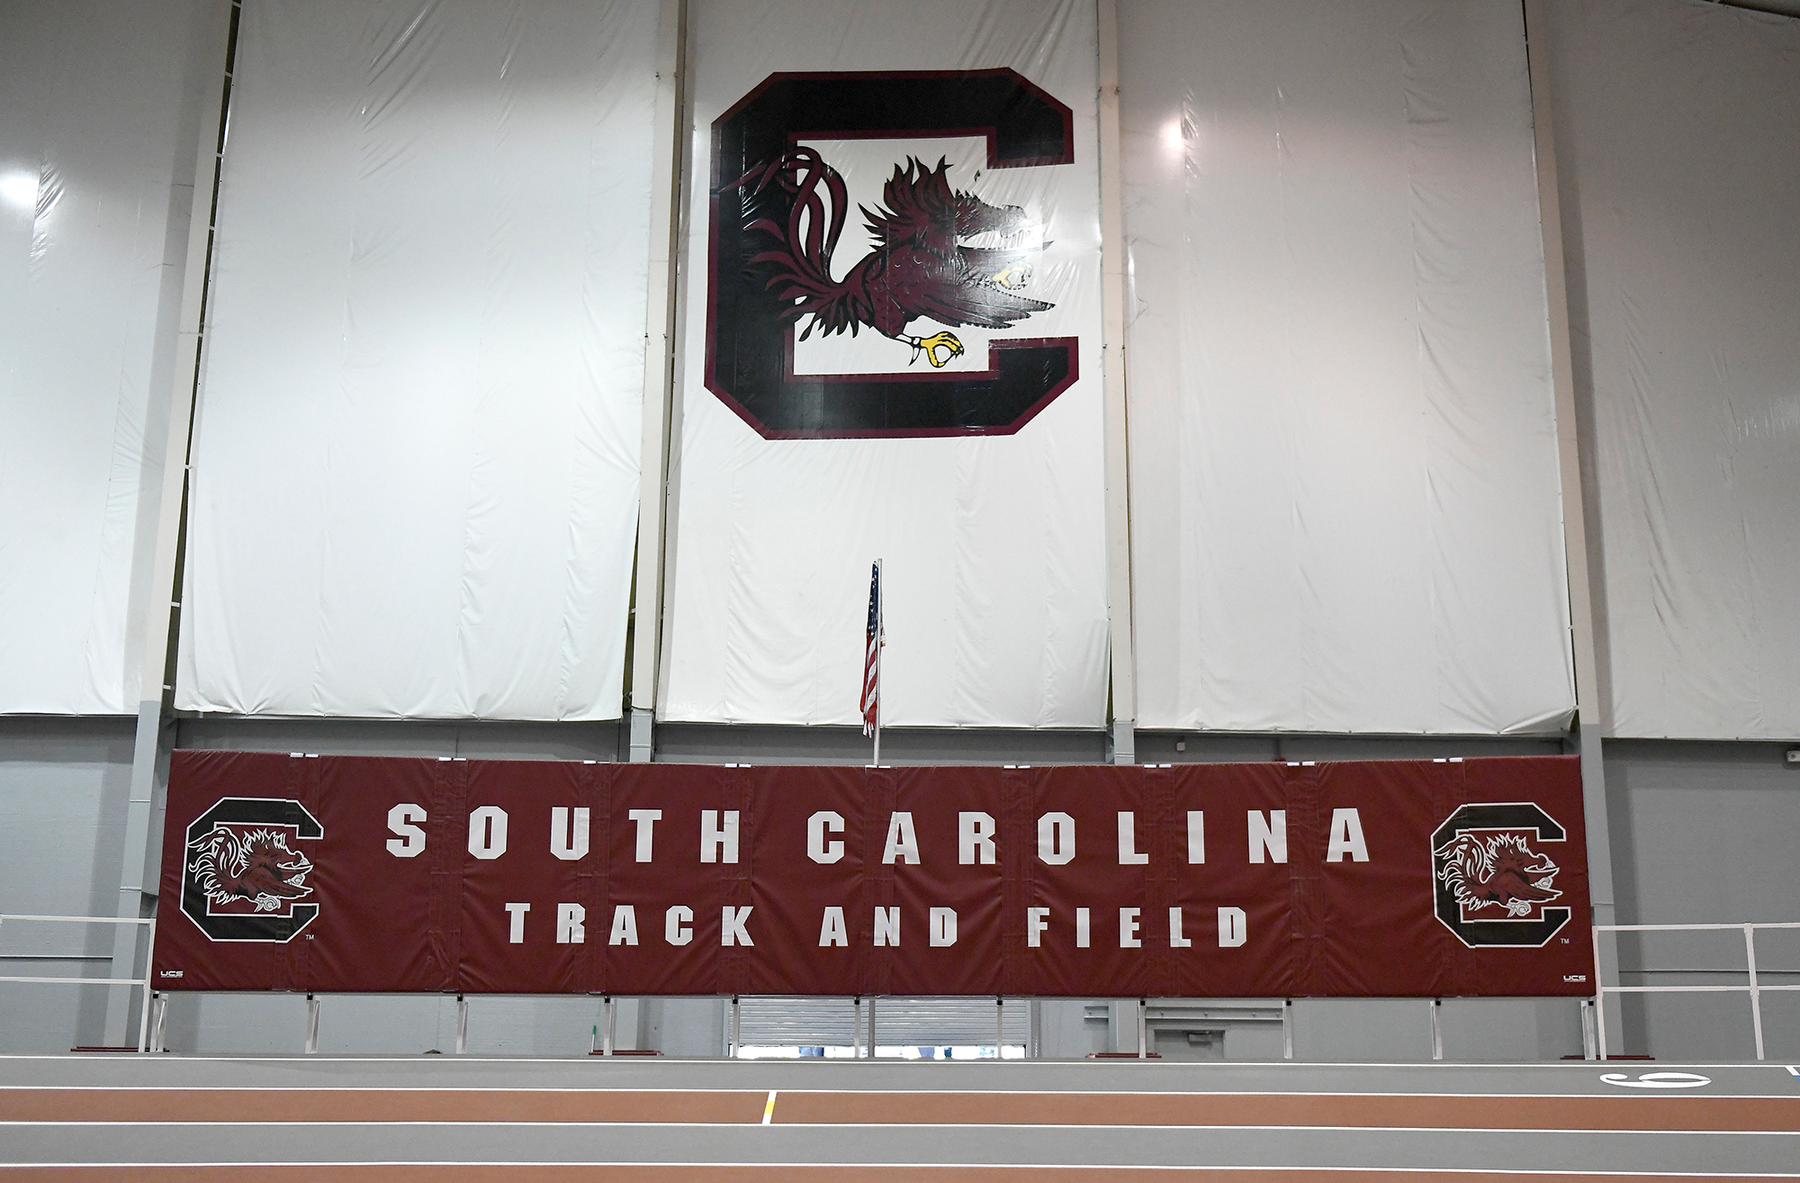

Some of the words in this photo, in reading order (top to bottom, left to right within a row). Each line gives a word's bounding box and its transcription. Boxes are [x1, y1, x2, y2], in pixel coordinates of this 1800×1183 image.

[386, 804, 740, 864] SOUTH
[807, 808, 1370, 865] CAROLINA
[505, 903, 755, 948] TRACK
[818, 906, 958, 948] AND
[1027, 906, 1247, 948] FIELD
[160, 970, 184, 978] UCS
[1563, 974, 1587, 982] UCS
